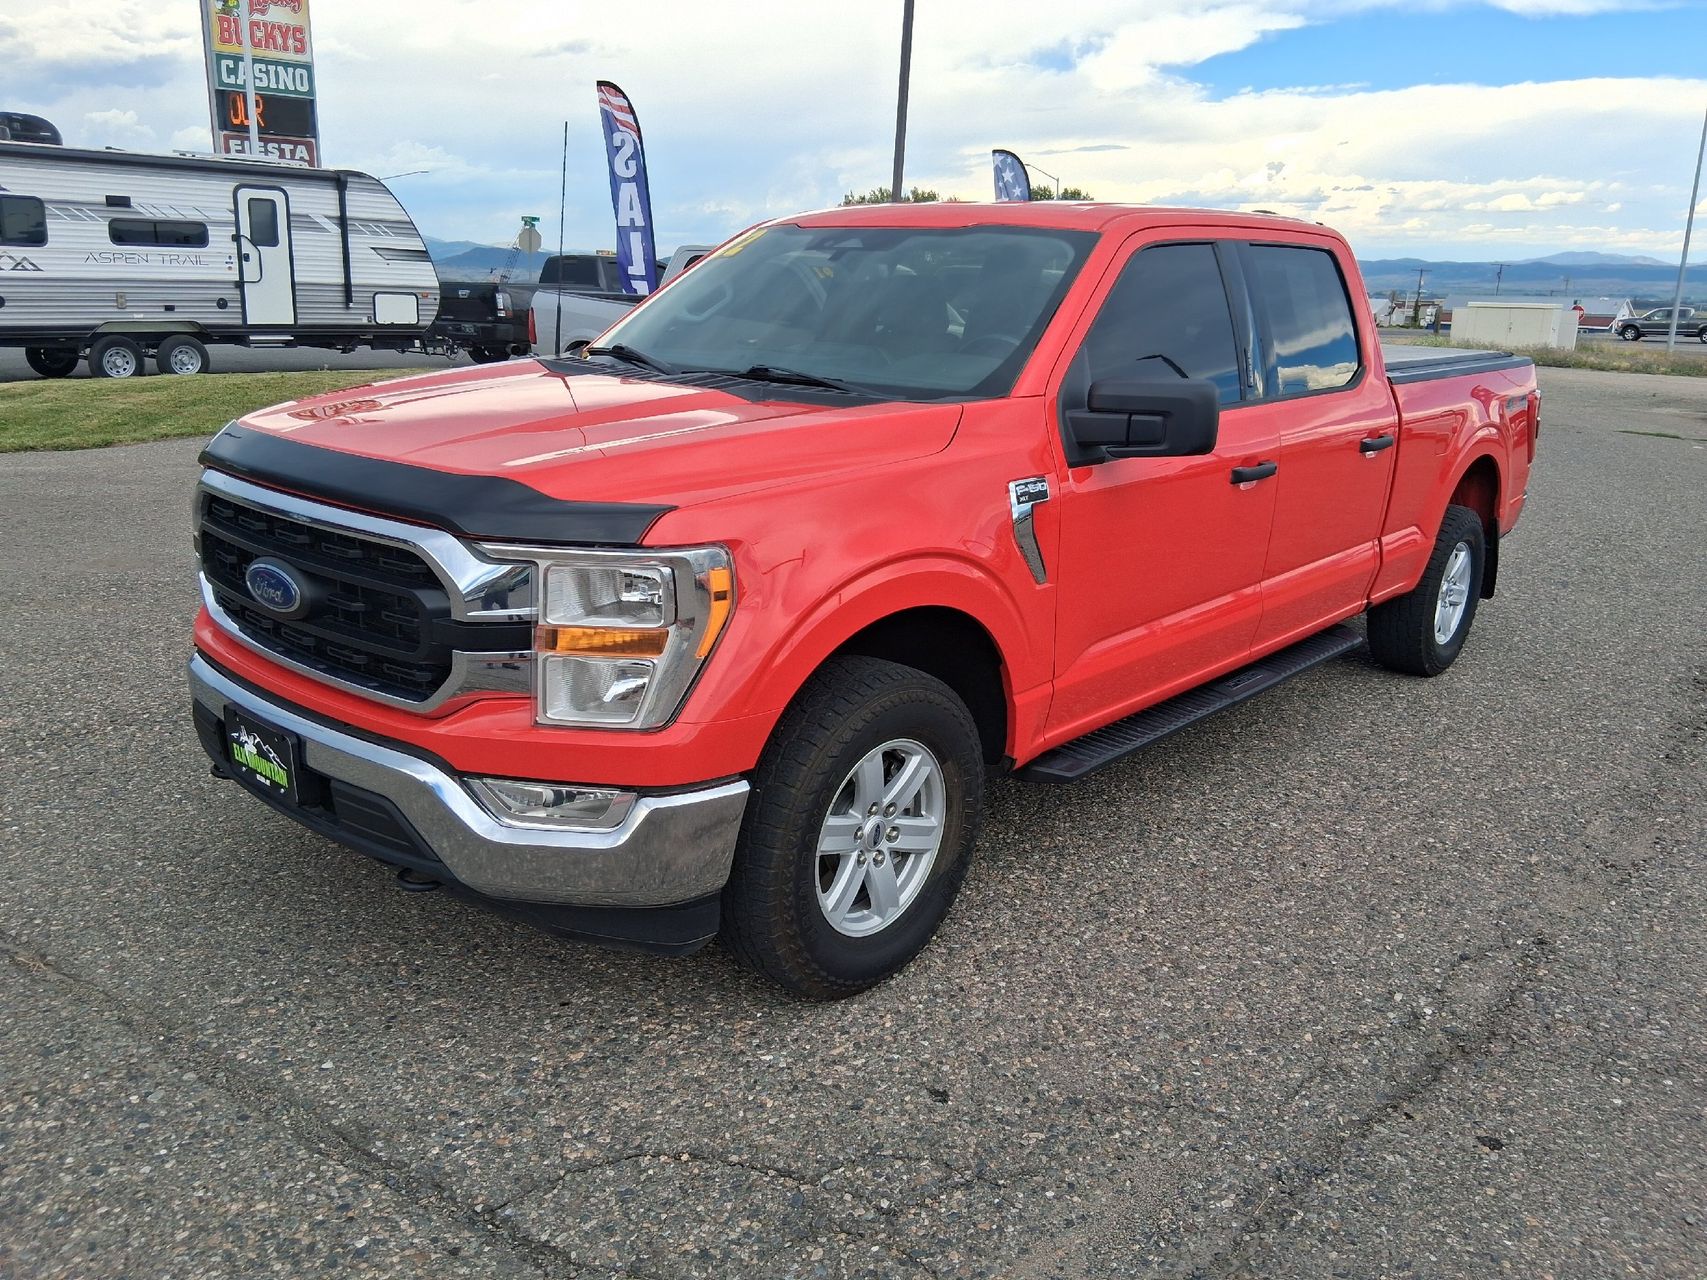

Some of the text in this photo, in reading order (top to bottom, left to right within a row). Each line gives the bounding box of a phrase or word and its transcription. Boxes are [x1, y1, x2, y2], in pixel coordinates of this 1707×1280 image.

[85, 252, 209, 266] ASPEN TRAIL
[254, 577, 284, 603] Ford
